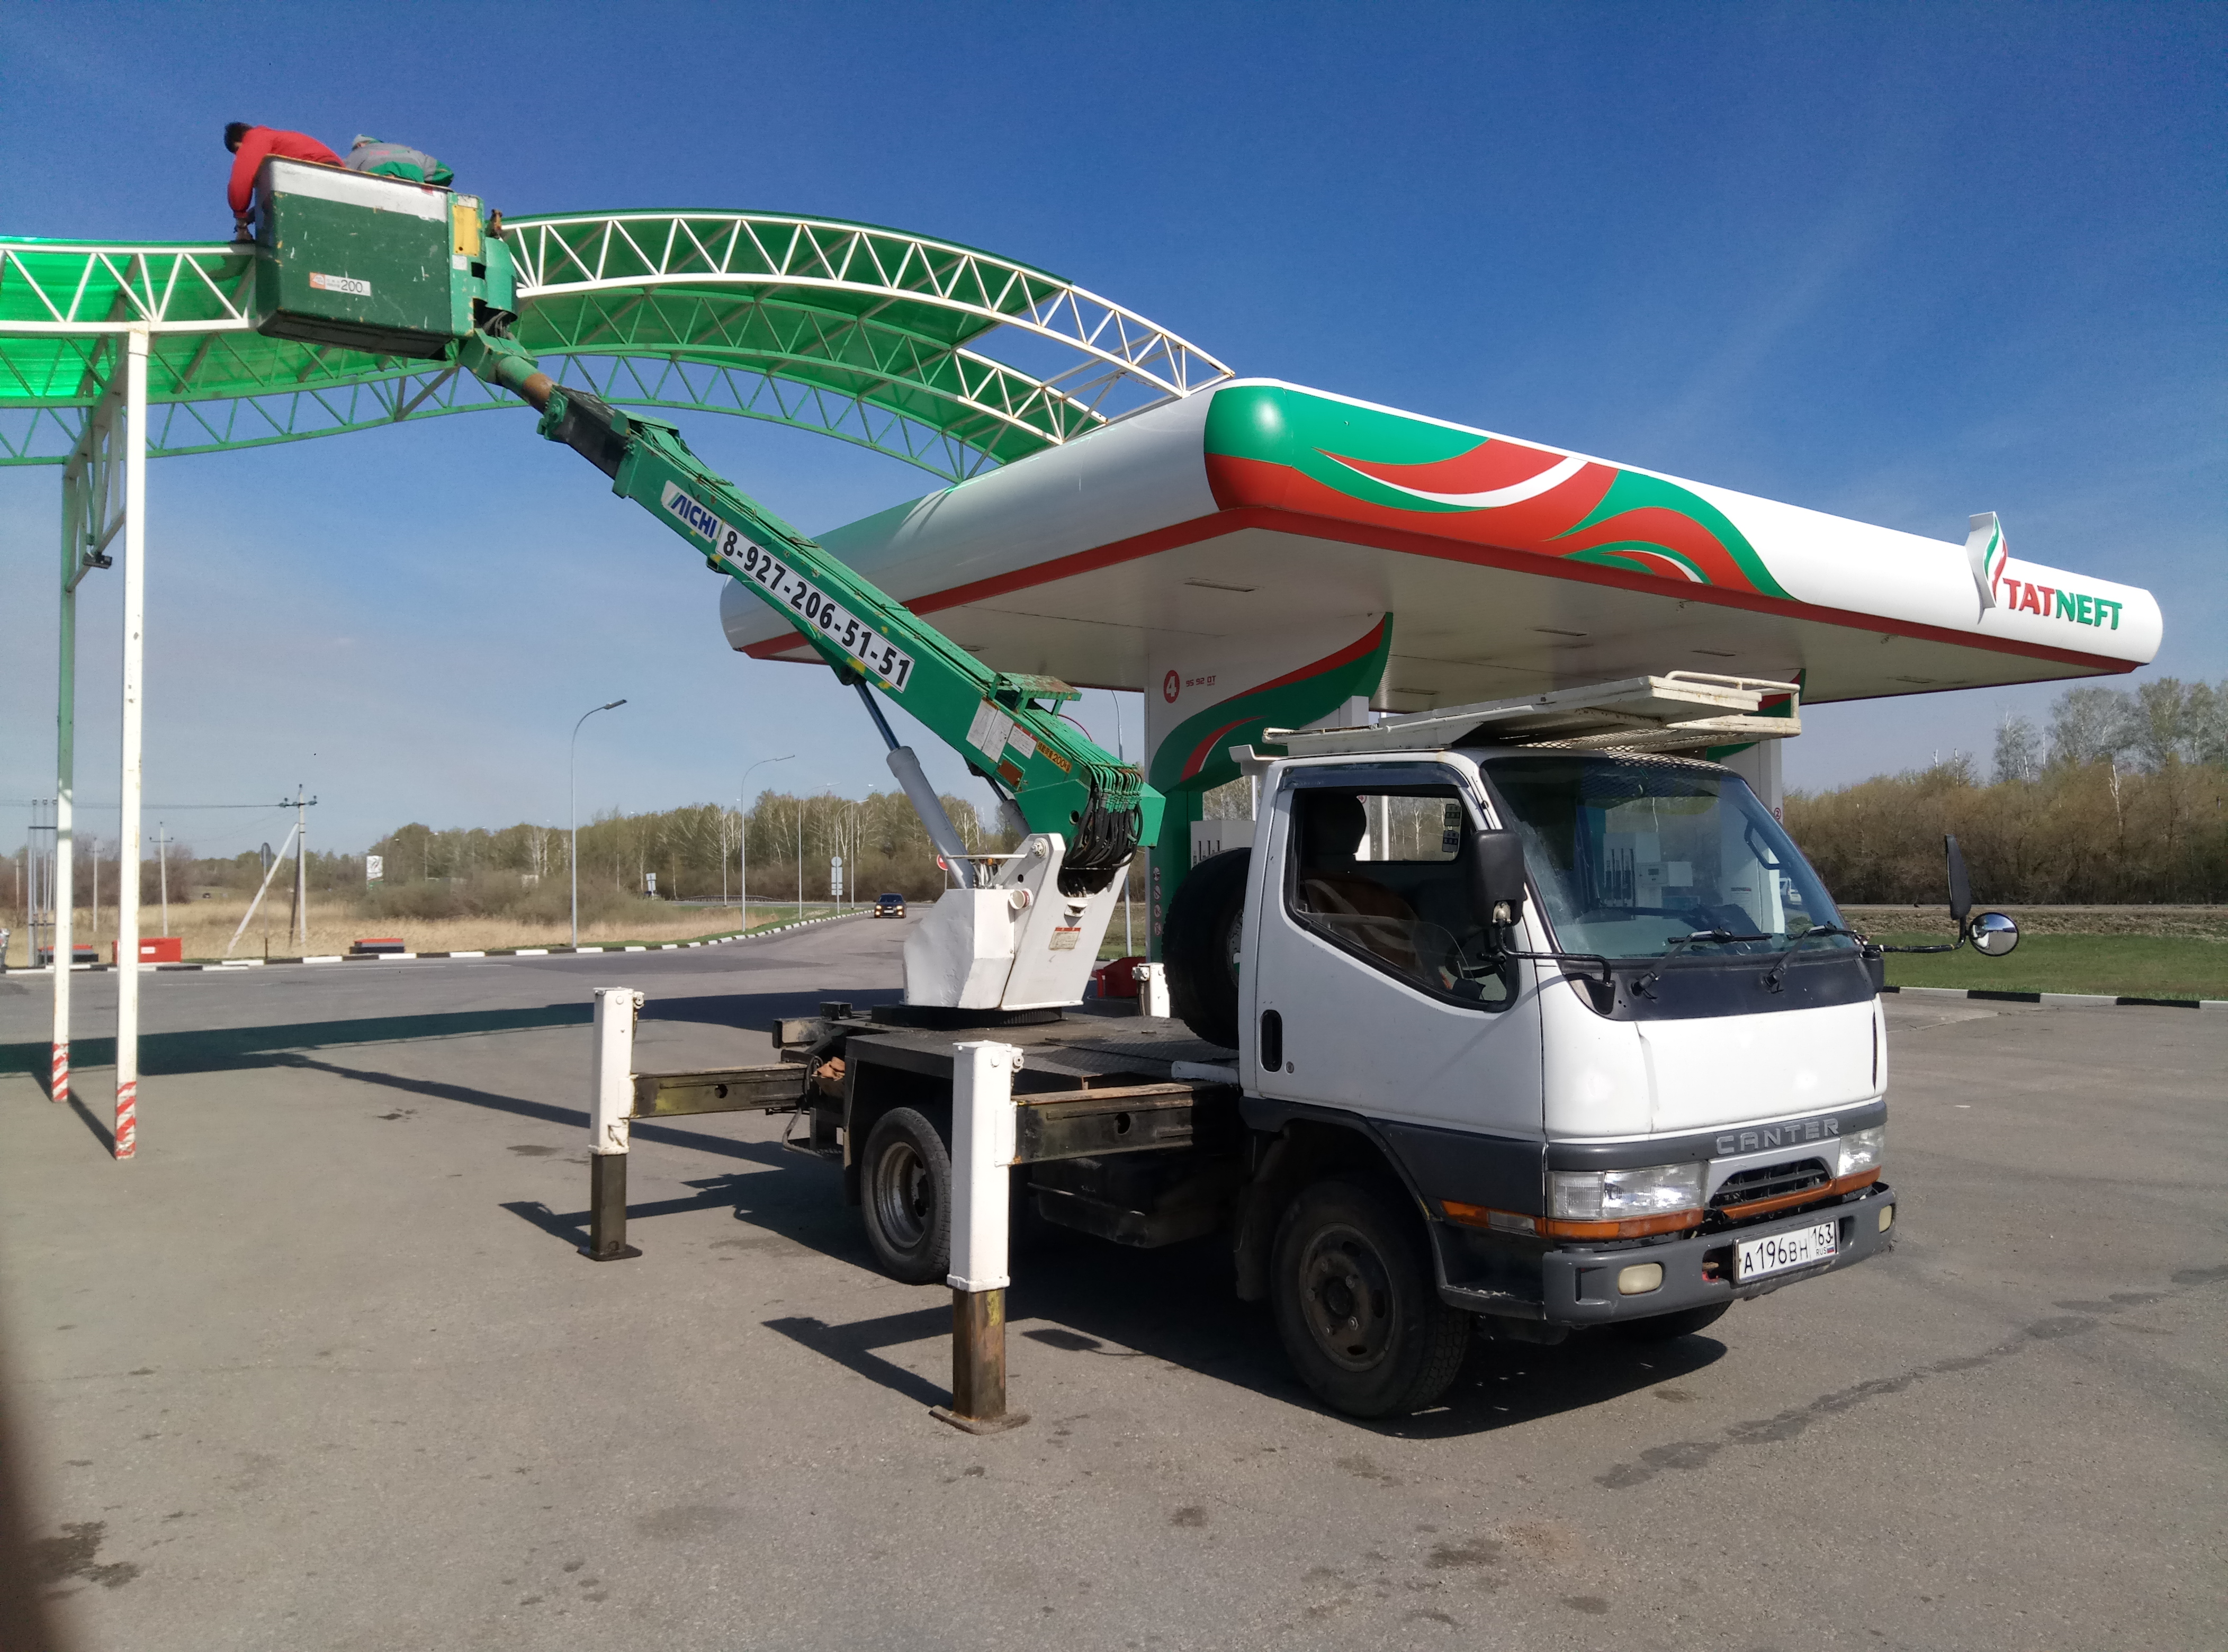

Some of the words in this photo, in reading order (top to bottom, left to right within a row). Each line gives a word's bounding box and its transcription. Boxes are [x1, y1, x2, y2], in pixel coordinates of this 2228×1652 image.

[340, 280, 363, 293] 200
[668, 492, 717, 539] AICHI
[723, 531, 911, 688] 8-927-206-51-51
[2002, 577, 2123, 631] TATNEFT
[1166, 676, 1177, 697] 4
[1716, 1118, 1839, 1155] CANTER
[1810, 1223, 1834, 1249] 163
[1816, 1246, 1827, 1256] RUS
